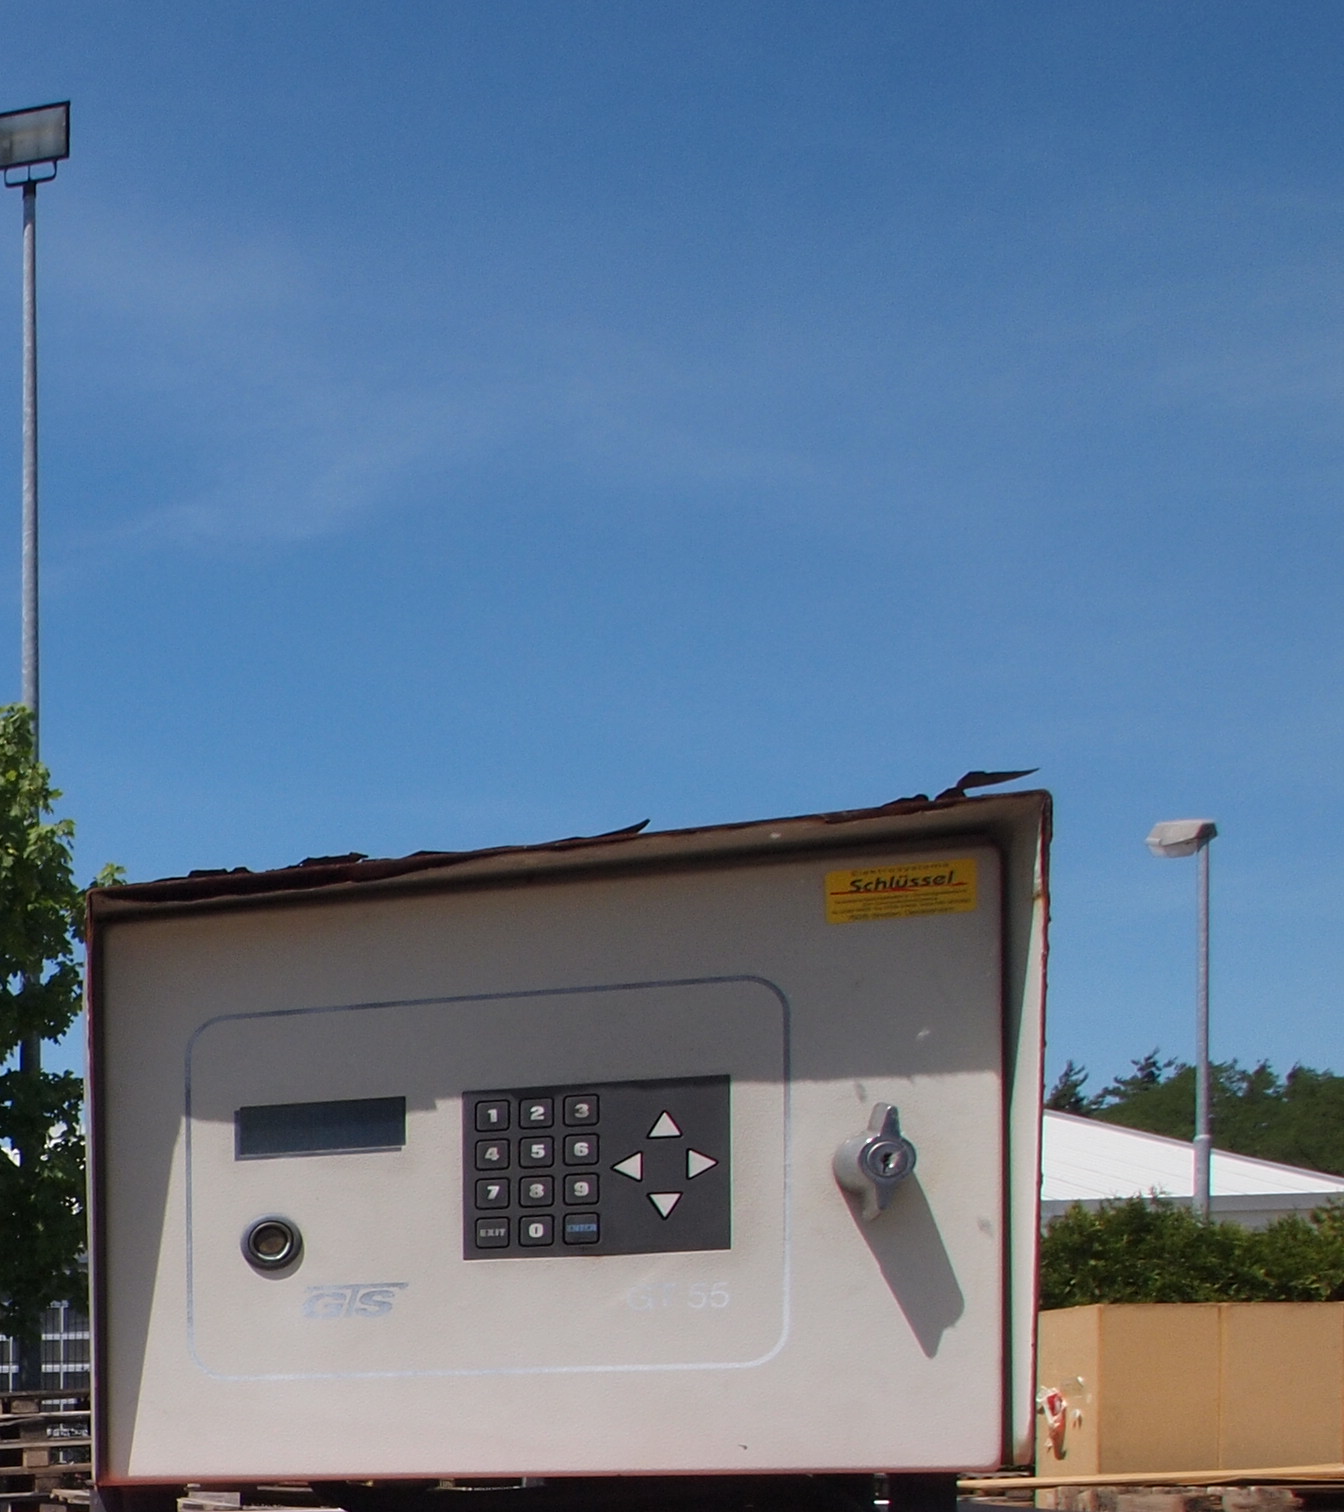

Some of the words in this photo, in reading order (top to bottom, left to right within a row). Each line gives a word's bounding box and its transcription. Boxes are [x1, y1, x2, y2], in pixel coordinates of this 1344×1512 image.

[849, 869, 954, 893] Schlüssel
[487, 1108, 498, 1123] 1
[529, 1106, 545, 1121] 2
[574, 1103, 590, 1119] 3
[484, 1147, 500, 1161] 4
[530, 1144, 545, 1159] 5
[573, 1142, 589, 1157] 6
[486, 1185, 500, 1200] 7
[529, 1183, 544, 1198] 8
[574, 1181, 589, 1197] 9
[479, 1228, 507, 1238] EXIT
[528, 1223, 544, 1238] 0
[567, 1223, 597, 1233] ENTER
[302, 1282, 409, 1318] GTS
[688, 1281, 730, 1309] 55
